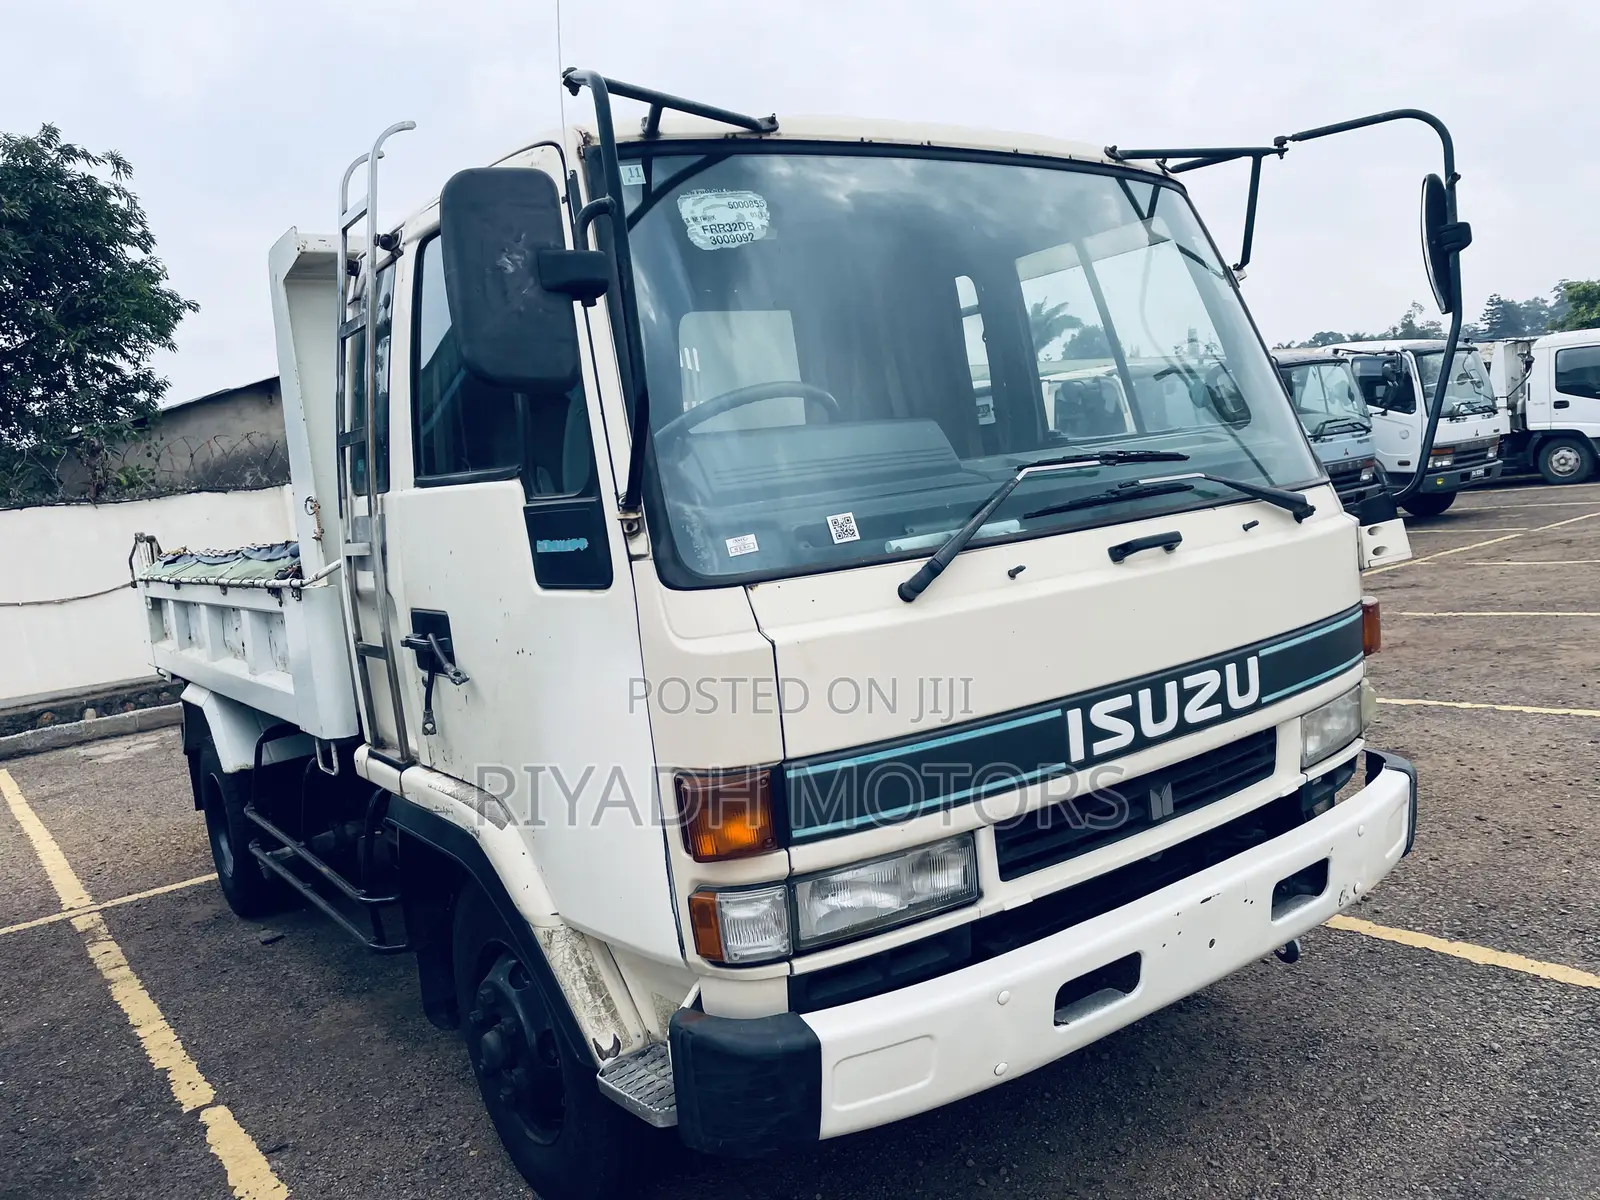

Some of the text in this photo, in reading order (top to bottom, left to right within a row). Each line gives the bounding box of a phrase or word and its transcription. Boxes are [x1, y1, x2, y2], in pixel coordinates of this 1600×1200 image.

[628, 166, 642, 178] 11
[727, 199, 766, 210] 5000855
[701, 221, 756, 235] FRR32DB
[709, 232, 755, 246] 3009092
[1067, 655, 1260, 762] ISUZU
